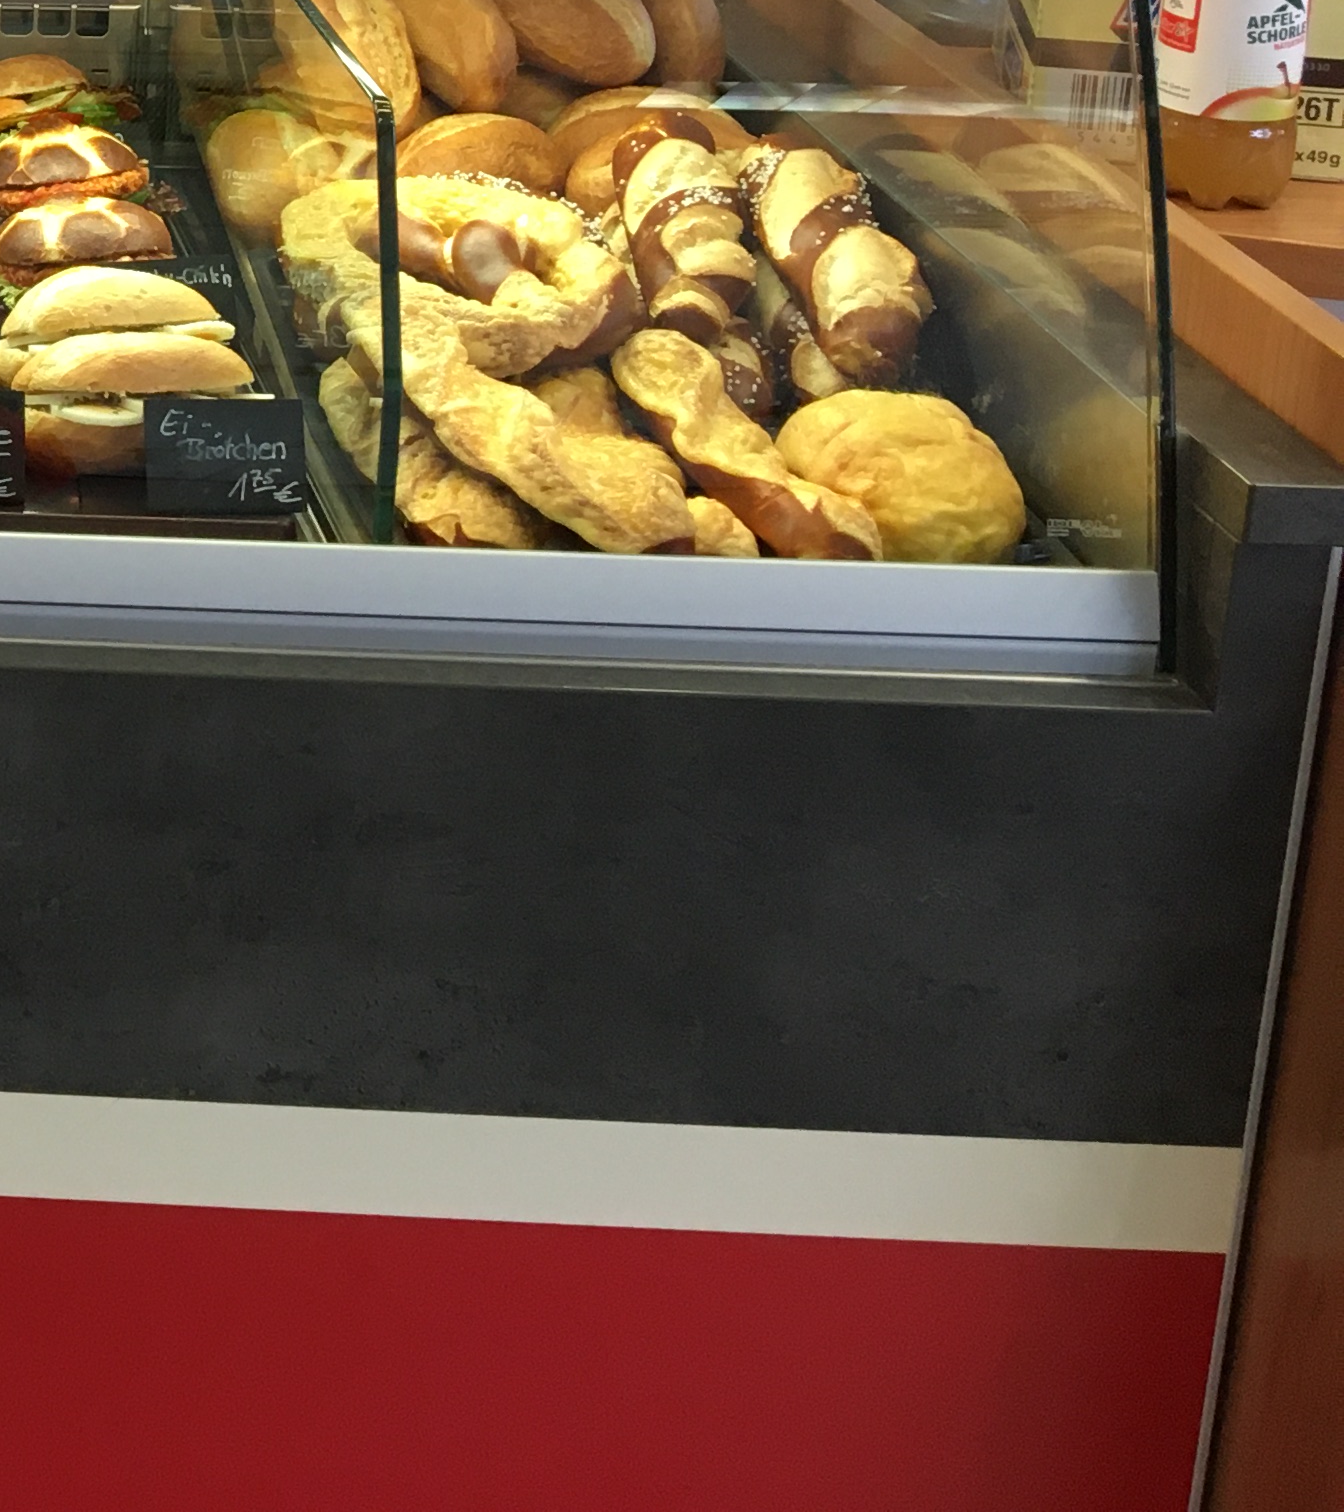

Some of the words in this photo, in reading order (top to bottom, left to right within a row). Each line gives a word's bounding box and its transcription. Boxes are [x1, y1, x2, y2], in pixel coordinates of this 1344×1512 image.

[1247, 11, 1301, 29] APFEL-
[1247, 20, 1306, 44] SCHORLE
[181, 432, 288, 461] Brötchen
